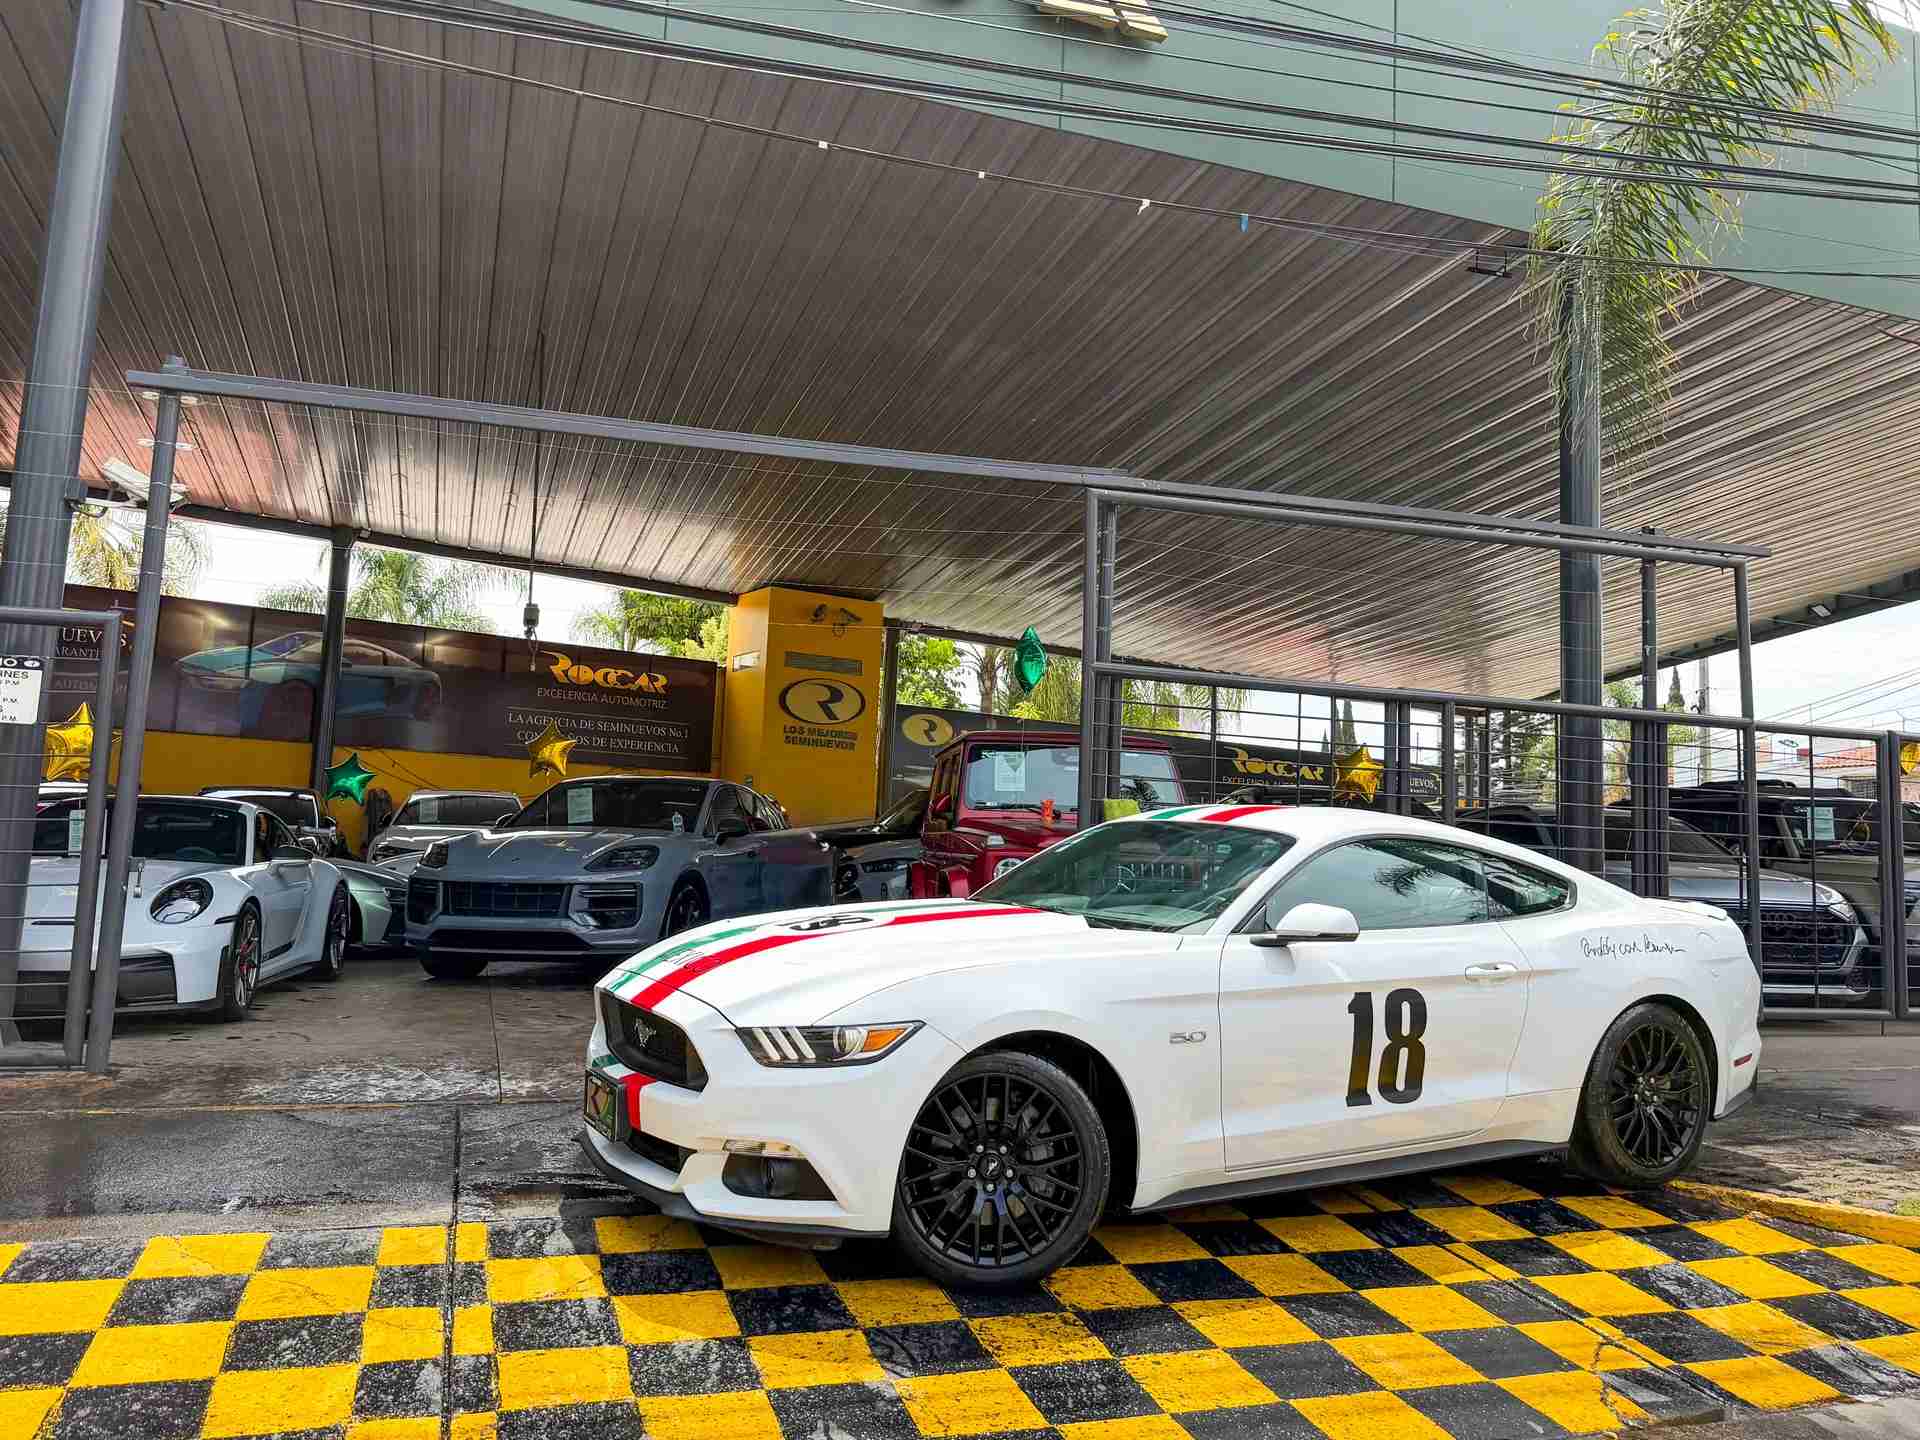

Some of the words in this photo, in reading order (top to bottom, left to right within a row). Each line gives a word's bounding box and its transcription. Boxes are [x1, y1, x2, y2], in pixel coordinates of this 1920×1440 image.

[537, 687, 600, 704] EXCELENCIA
[600, 692, 668, 711] AUTOMOTRIZ
[508, 711, 524, 725] LA
[579, 719, 594, 730] DE
[596, 720, 667, 738] SEMINUEVOS
[592, 735, 609, 747] DE
[610, 737, 679, 754] EXPERIENCIA
[1345, 987, 1428, 1108] 18
